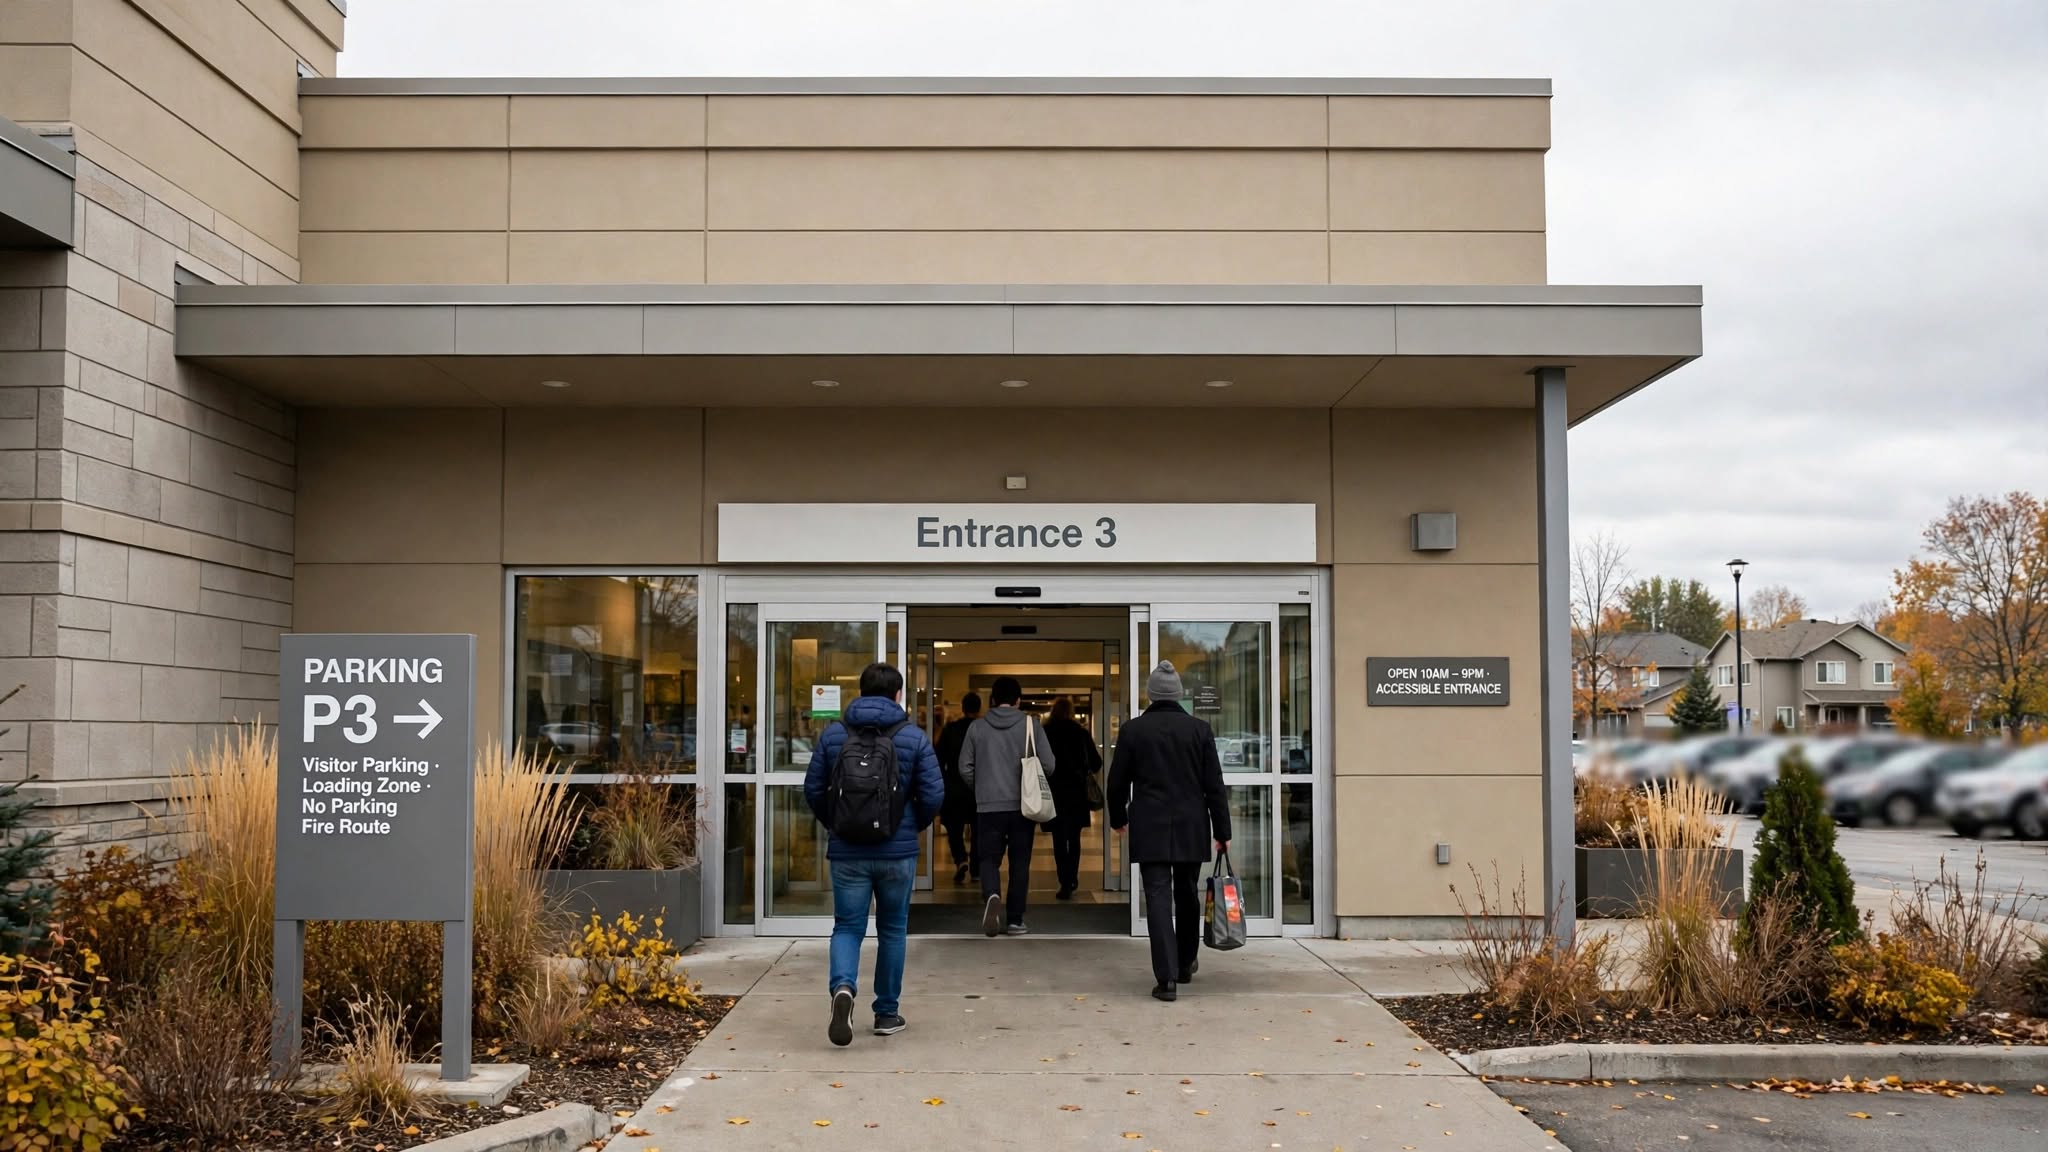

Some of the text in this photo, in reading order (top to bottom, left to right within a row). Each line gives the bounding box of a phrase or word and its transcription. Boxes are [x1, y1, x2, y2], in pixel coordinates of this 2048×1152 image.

[917, 516, 1117, 549] Entrance 3
[304, 657, 443, 684] PARKING
[1387, 668, 1417, 679] OPEN
[1421, 668, 1449, 679] 10AM
[1461, 668, 1484, 679] 9PM
[1375, 683, 1502, 694] ACCESSIBLE ENTRANCE
[303, 694, 378, 744] P3
[302, 757, 358, 773] Visitor
[362, 757, 429, 776] Parking
[302, 777, 373, 797] Loading
[376, 777, 422, 793] Zone
[302, 798, 398, 818] No Parking
[301, 818, 391, 835] Fire Route
